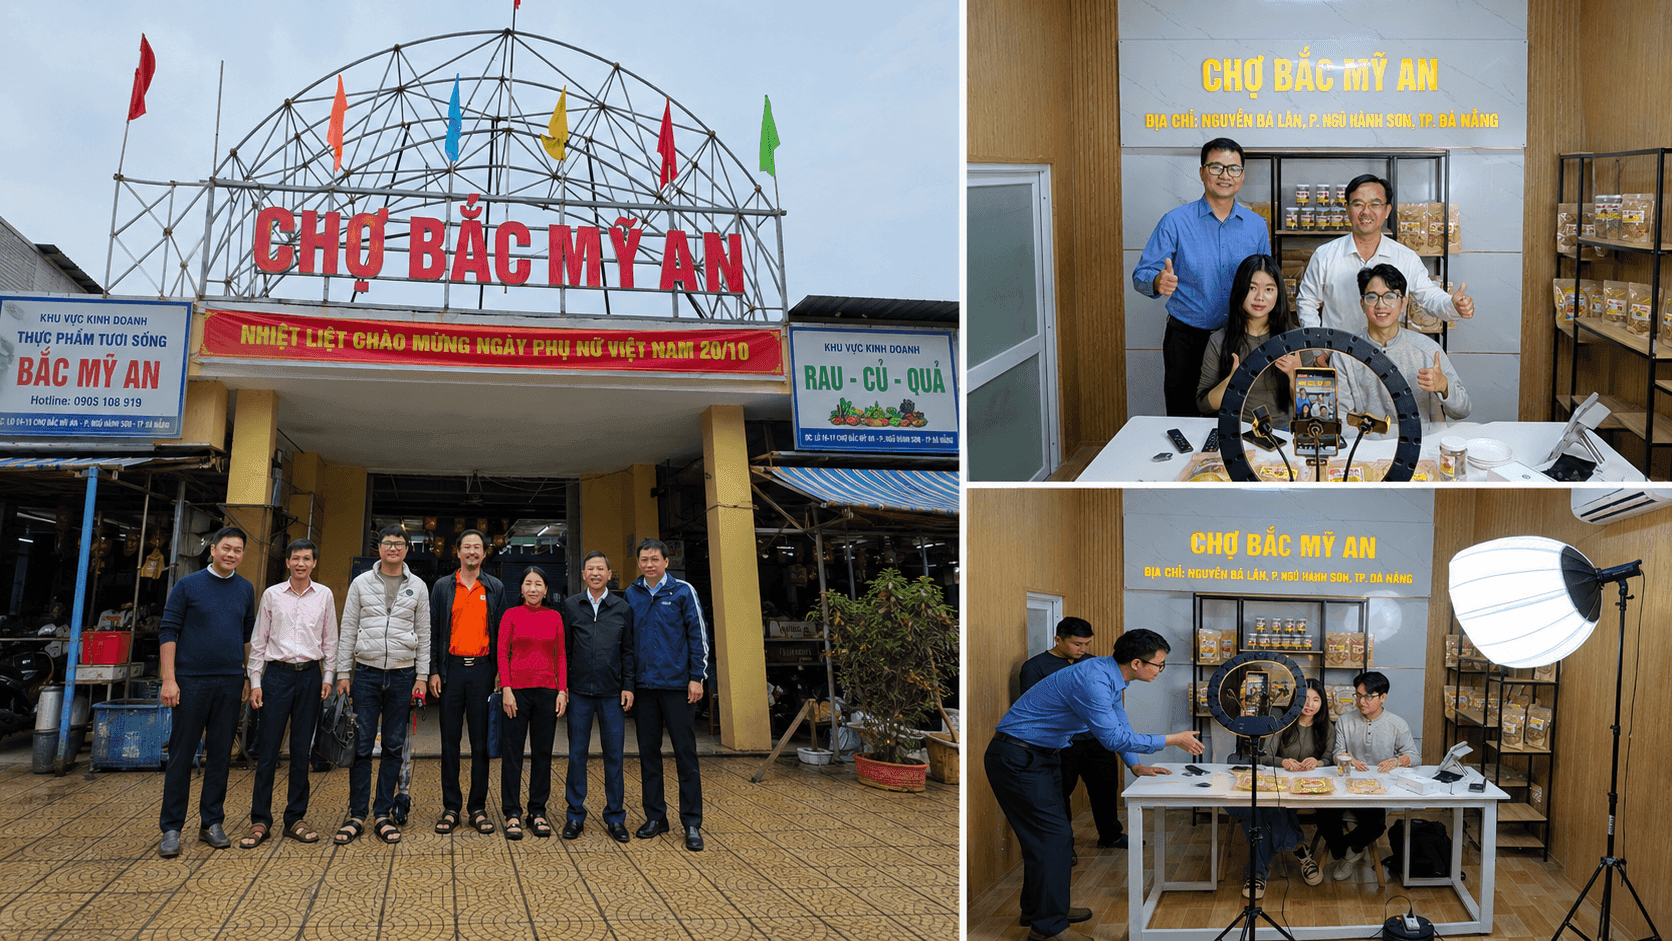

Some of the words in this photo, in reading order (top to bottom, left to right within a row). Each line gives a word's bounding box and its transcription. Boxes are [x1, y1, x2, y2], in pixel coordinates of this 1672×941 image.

[1202, 54, 1264, 99] CHỢ
[1273, 45, 1334, 92] BẮC
[1343, 51, 1388, 92] MỸ
[1396, 58, 1438, 92] AN
[1145, 113, 1168, 132] ĐỊA
[1171, 108, 1199, 128] CHỈ:
[1256, 110, 1274, 128] BÁ
[1309, 113, 1320, 128] P.
[1322, 110, 1346, 128] NGŨ
[1349, 110, 1383, 128] HÀNH
[1419, 113, 1436, 128] TP.
[1438, 110, 1457, 128] ĐÀ
[254, 206, 389, 293] CHỢ
[409, 193, 531, 285] BẮC
[548, 217, 643, 290] MỸ
[659, 229, 745, 294] AN
[40, 313, 61, 323] KHU
[64, 314, 84, 326] VỰC
[86, 315, 110, 325] KINH
[113, 316, 148, 326] DOANH
[17, 330, 52, 347] THỰC
[56, 328, 95, 345] PHẨM
[98, 332, 128, 346] TƯƠI
[131, 331, 167, 348] SỐNG
[240, 323, 300, 350] NHIỆT
[306, 326, 348, 352] LIỆT
[353, 329, 405, 351] CHÀO
[412, 331, 470, 354] MỪNG
[476, 334, 528, 356] NGÀY
[532, 339, 571, 361] PHỤ
[576, 337, 604, 358] NỮ
[607, 337, 646, 362] VIỆT
[651, 341, 694, 360] NAM
[699, 341, 750, 361] 20/10
[824, 342, 843, 352] KHU
[845, 343, 864, 355] VỰC
[865, 344, 887, 353] KINH
[890, 345, 920, 354] DOANH
[16, 346, 69, 387] BẮC
[76, 353, 118, 388] MỸ
[123, 360, 161, 389] AN
[804, 365, 843, 391] RAU
[863, 358, 888, 392] CỦ
[907, 360, 946, 396] QUẢ
[30, 395, 70, 406] Hotline:
[74, 396, 99, 407] 0905
[103, 397, 120, 407] 108
[123, 398, 142, 407] 919
[1190, 530, 1240, 560] CHỢ
[1246, 525, 1292, 557] BẮC
[1300, 531, 1336, 559] MỸ
[1342, 535, 1376, 559] AN
[1144, 566, 1161, 580] ĐỊA
[1164, 564, 1185, 578] CHỈ:
[1230, 567, 1244, 580] BÁ
[1271, 571, 1280, 581] P.
[1302, 570, 1328, 583] HÀNH
[1354, 572, 1368, 583] TP.
